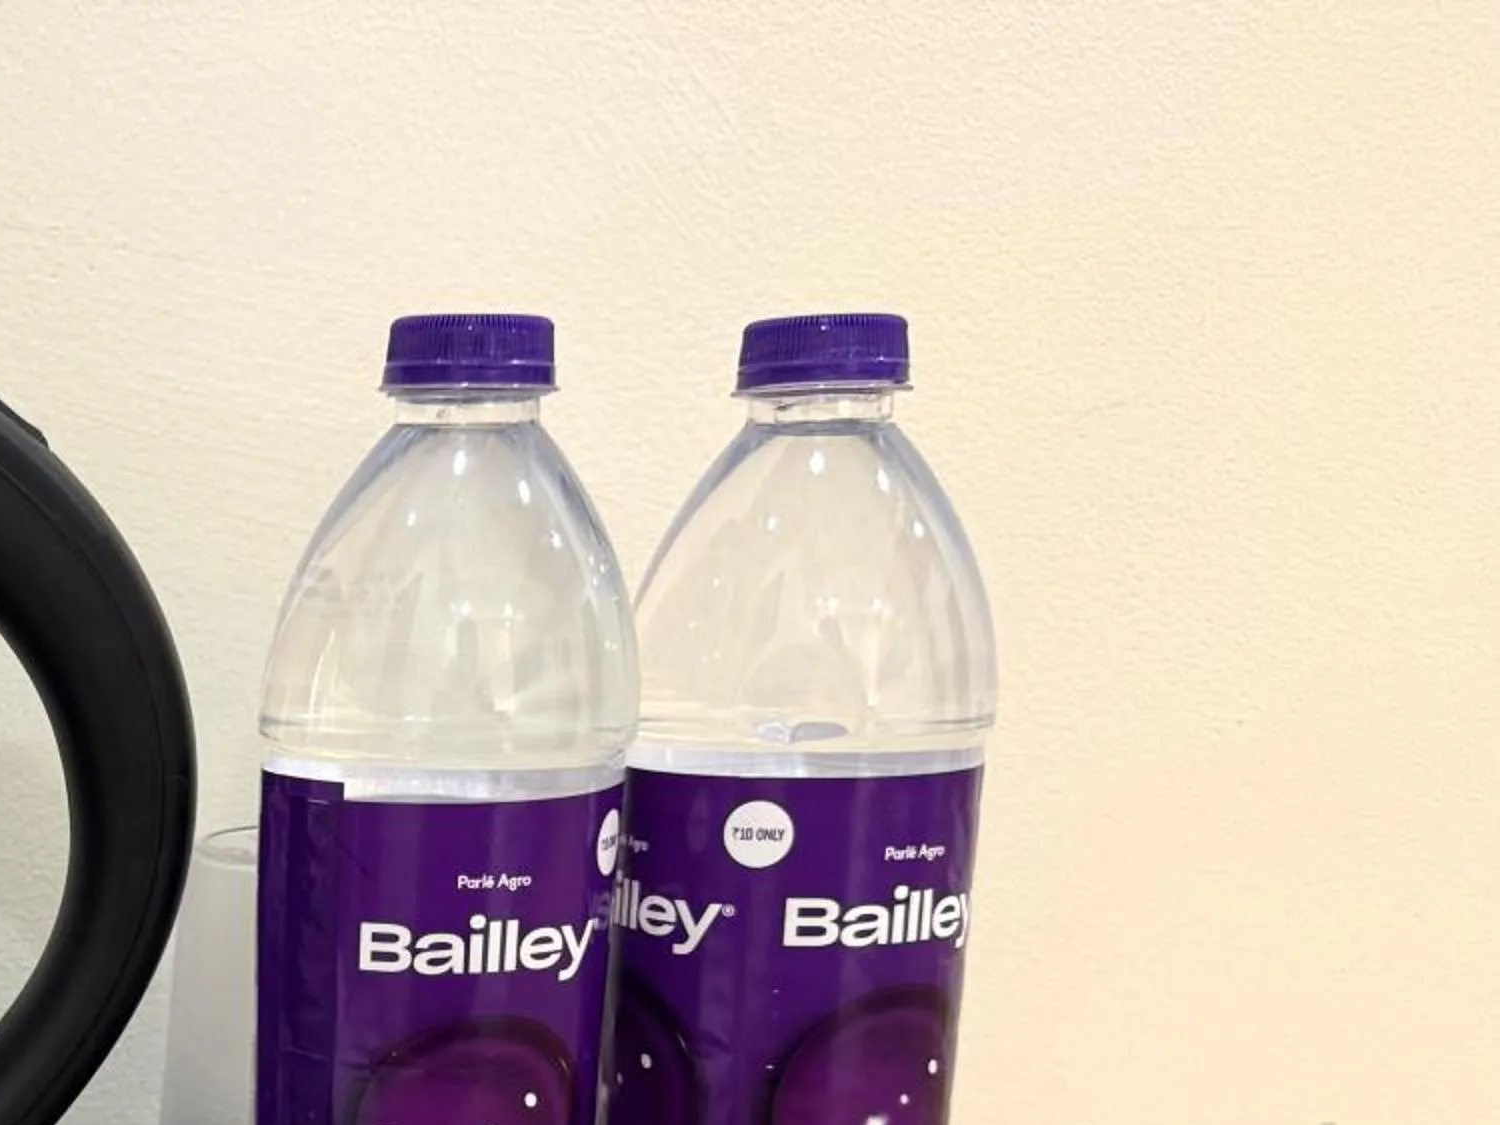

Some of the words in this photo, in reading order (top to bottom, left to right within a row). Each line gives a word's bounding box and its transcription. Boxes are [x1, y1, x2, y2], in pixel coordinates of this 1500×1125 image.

[755, 827, 787, 842] ONLY
[918, 844, 946, 861] Agro
[496, 873, 533, 891] Agro
[612, 869, 723, 956] illey
[358, 914, 597, 982] Bailley
